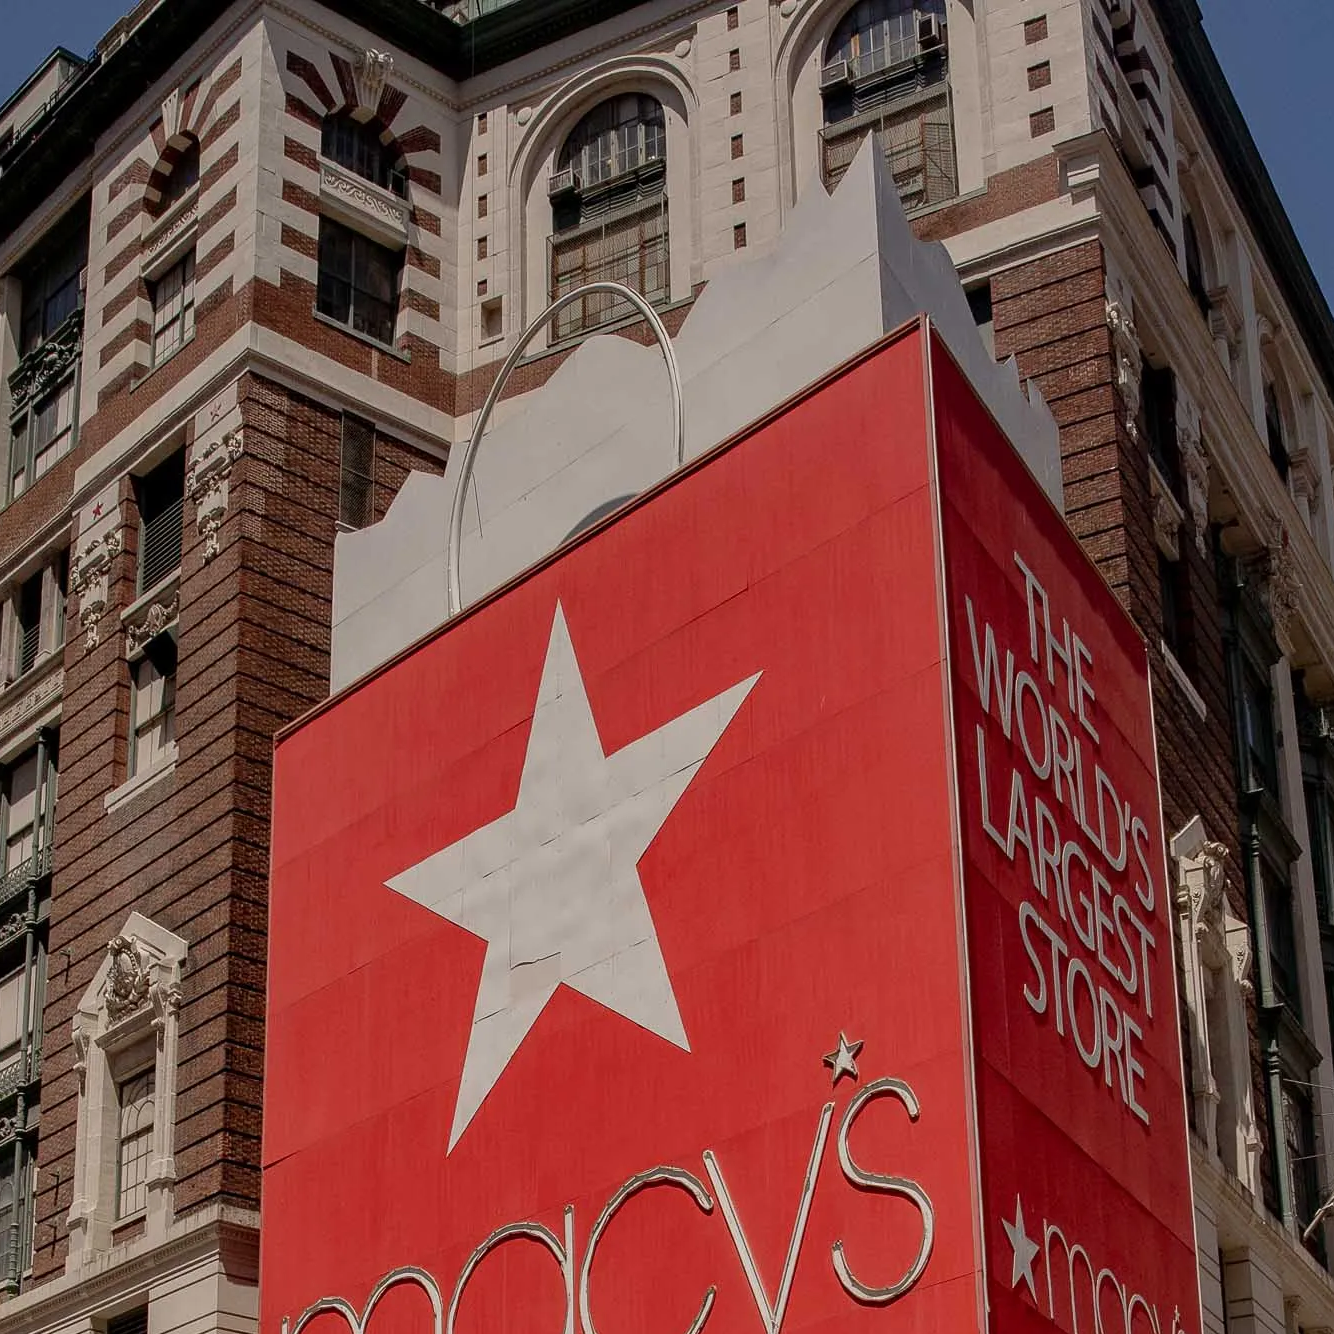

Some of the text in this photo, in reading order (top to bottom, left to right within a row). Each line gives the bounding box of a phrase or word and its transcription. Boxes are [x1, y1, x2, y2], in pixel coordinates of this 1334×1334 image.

[964, 594, 1157, 912] WORLD'S
[1012, 549, 1100, 745] THE
[975, 722, 1157, 1019] LARGEST
[1018, 900, 1151, 1127] STORE
